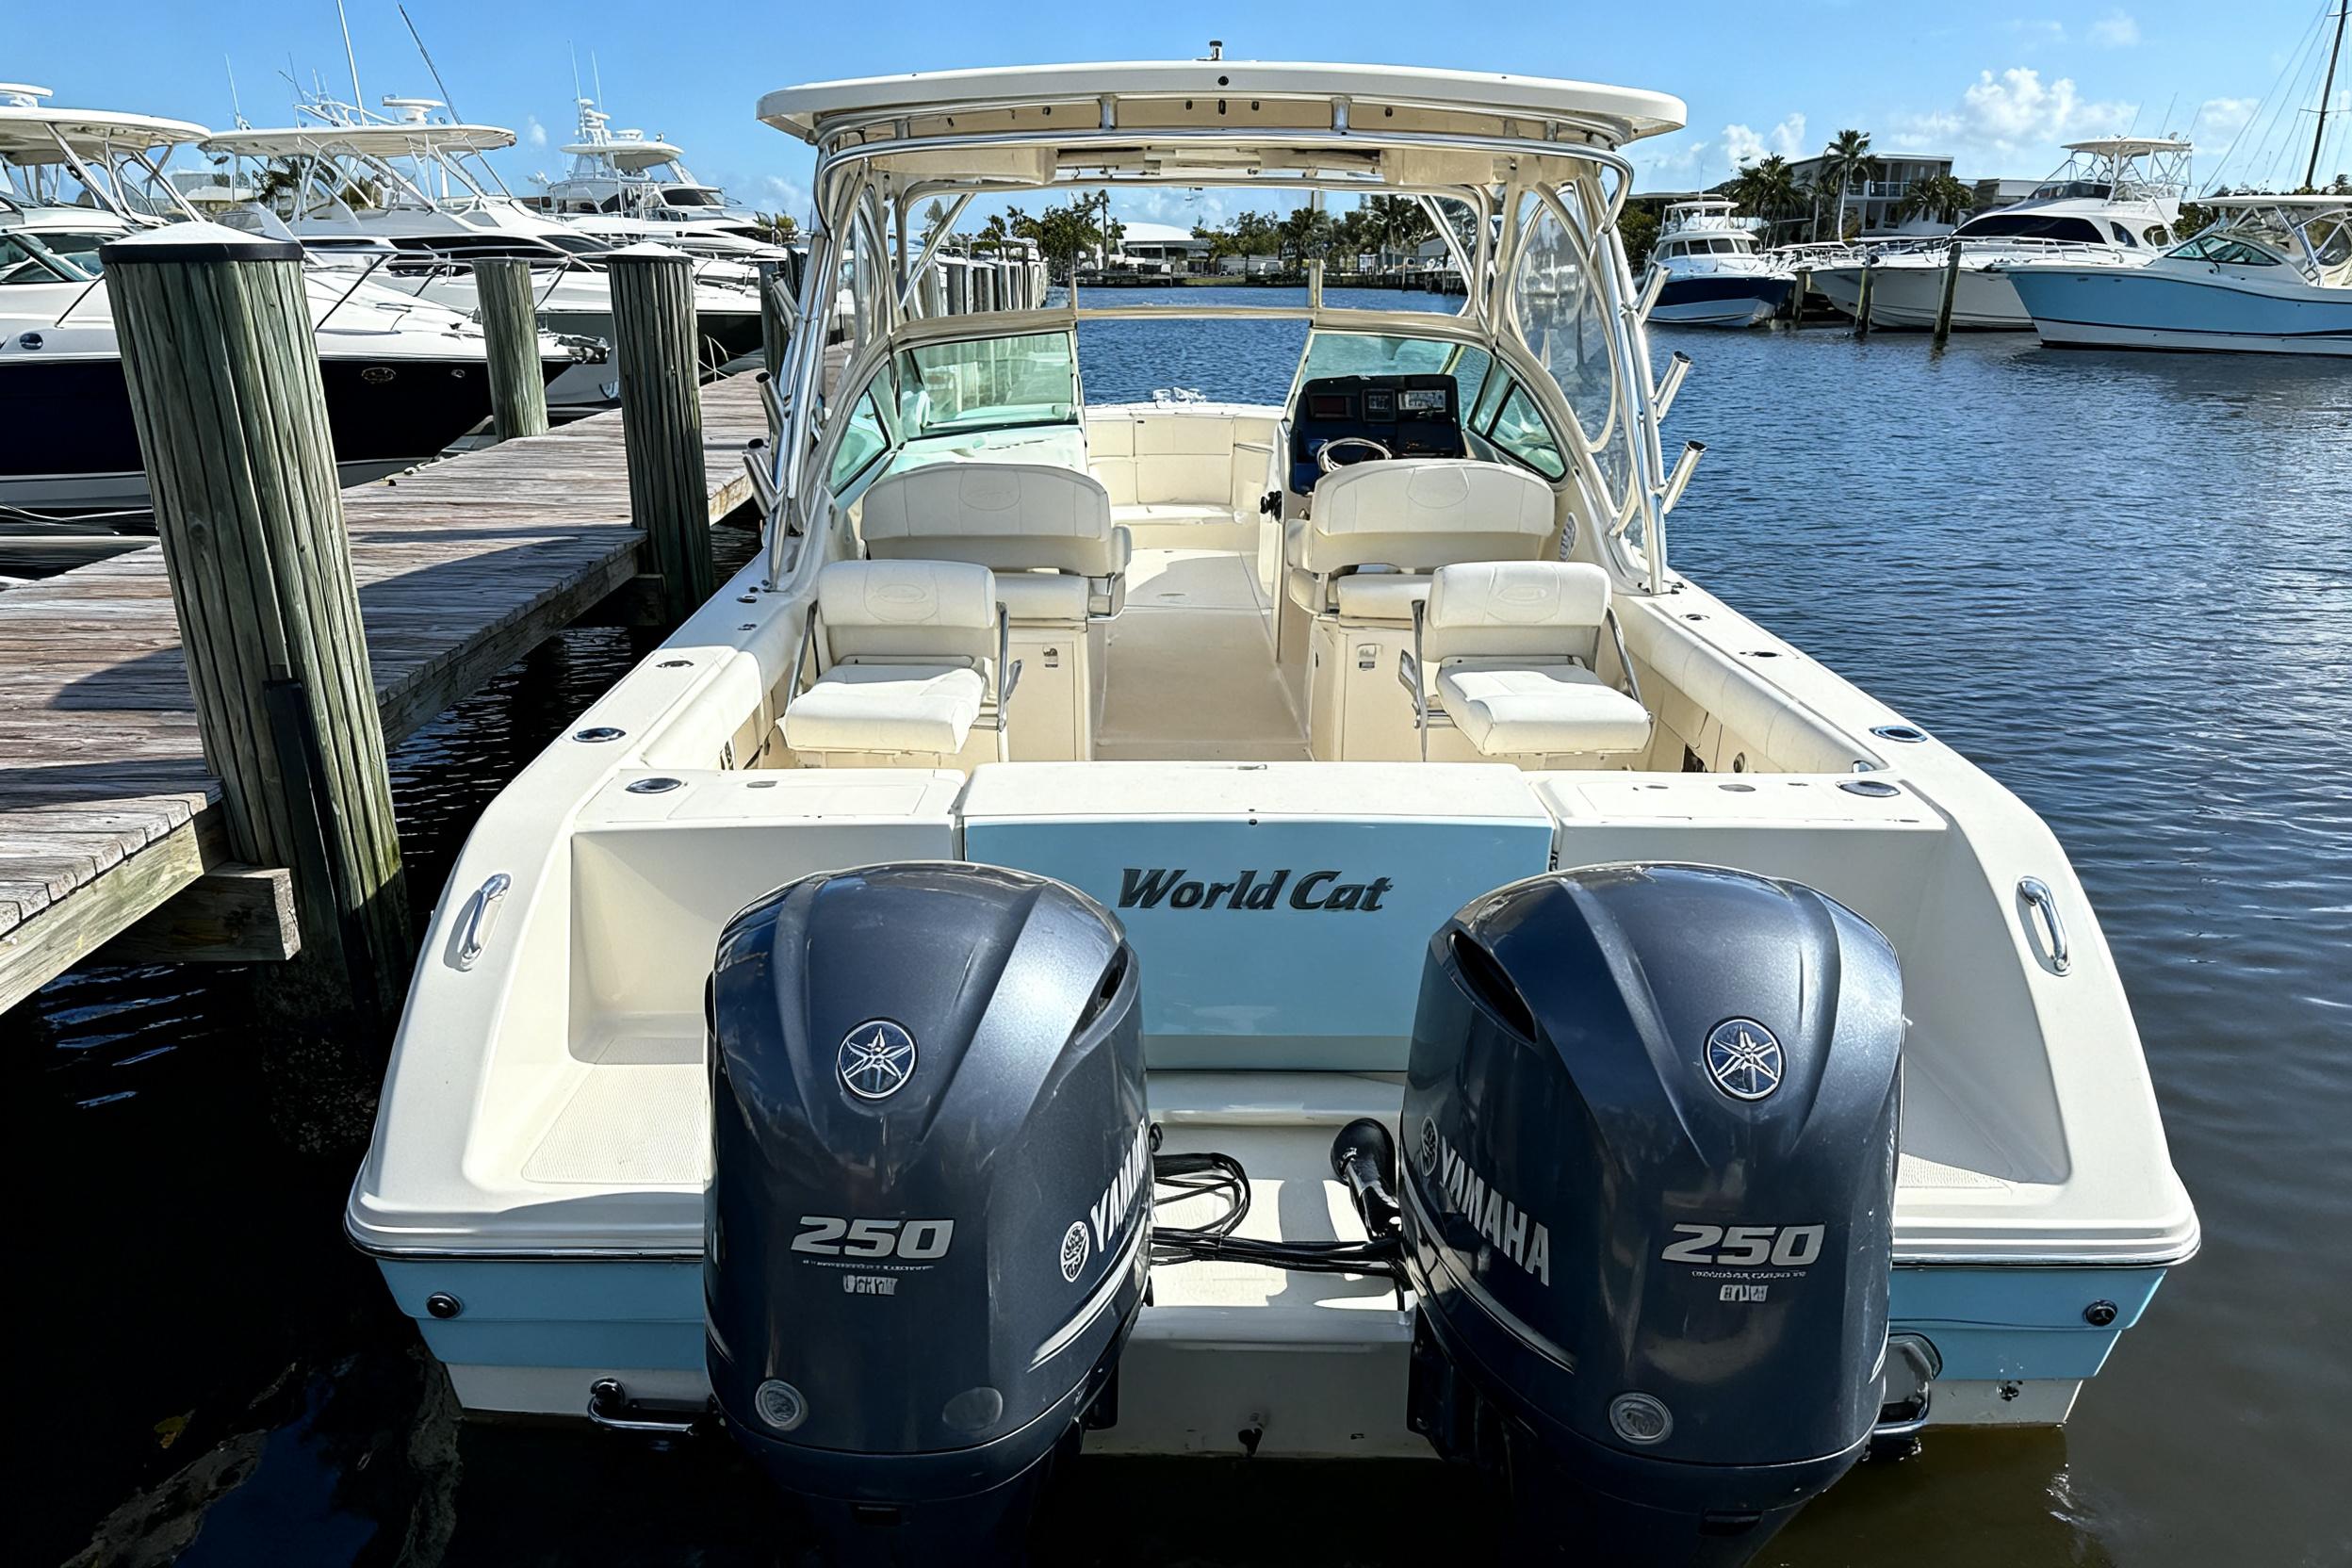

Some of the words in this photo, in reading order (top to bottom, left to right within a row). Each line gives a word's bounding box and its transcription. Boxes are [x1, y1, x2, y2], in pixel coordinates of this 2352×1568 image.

[1118, 868, 1292, 910] World
[1288, 870, 1395, 912] Cat
[1439, 1135, 1550, 1287] YAMAHA
[791, 1216, 955, 1259] 250
[1661, 1223, 1826, 1266] 250
